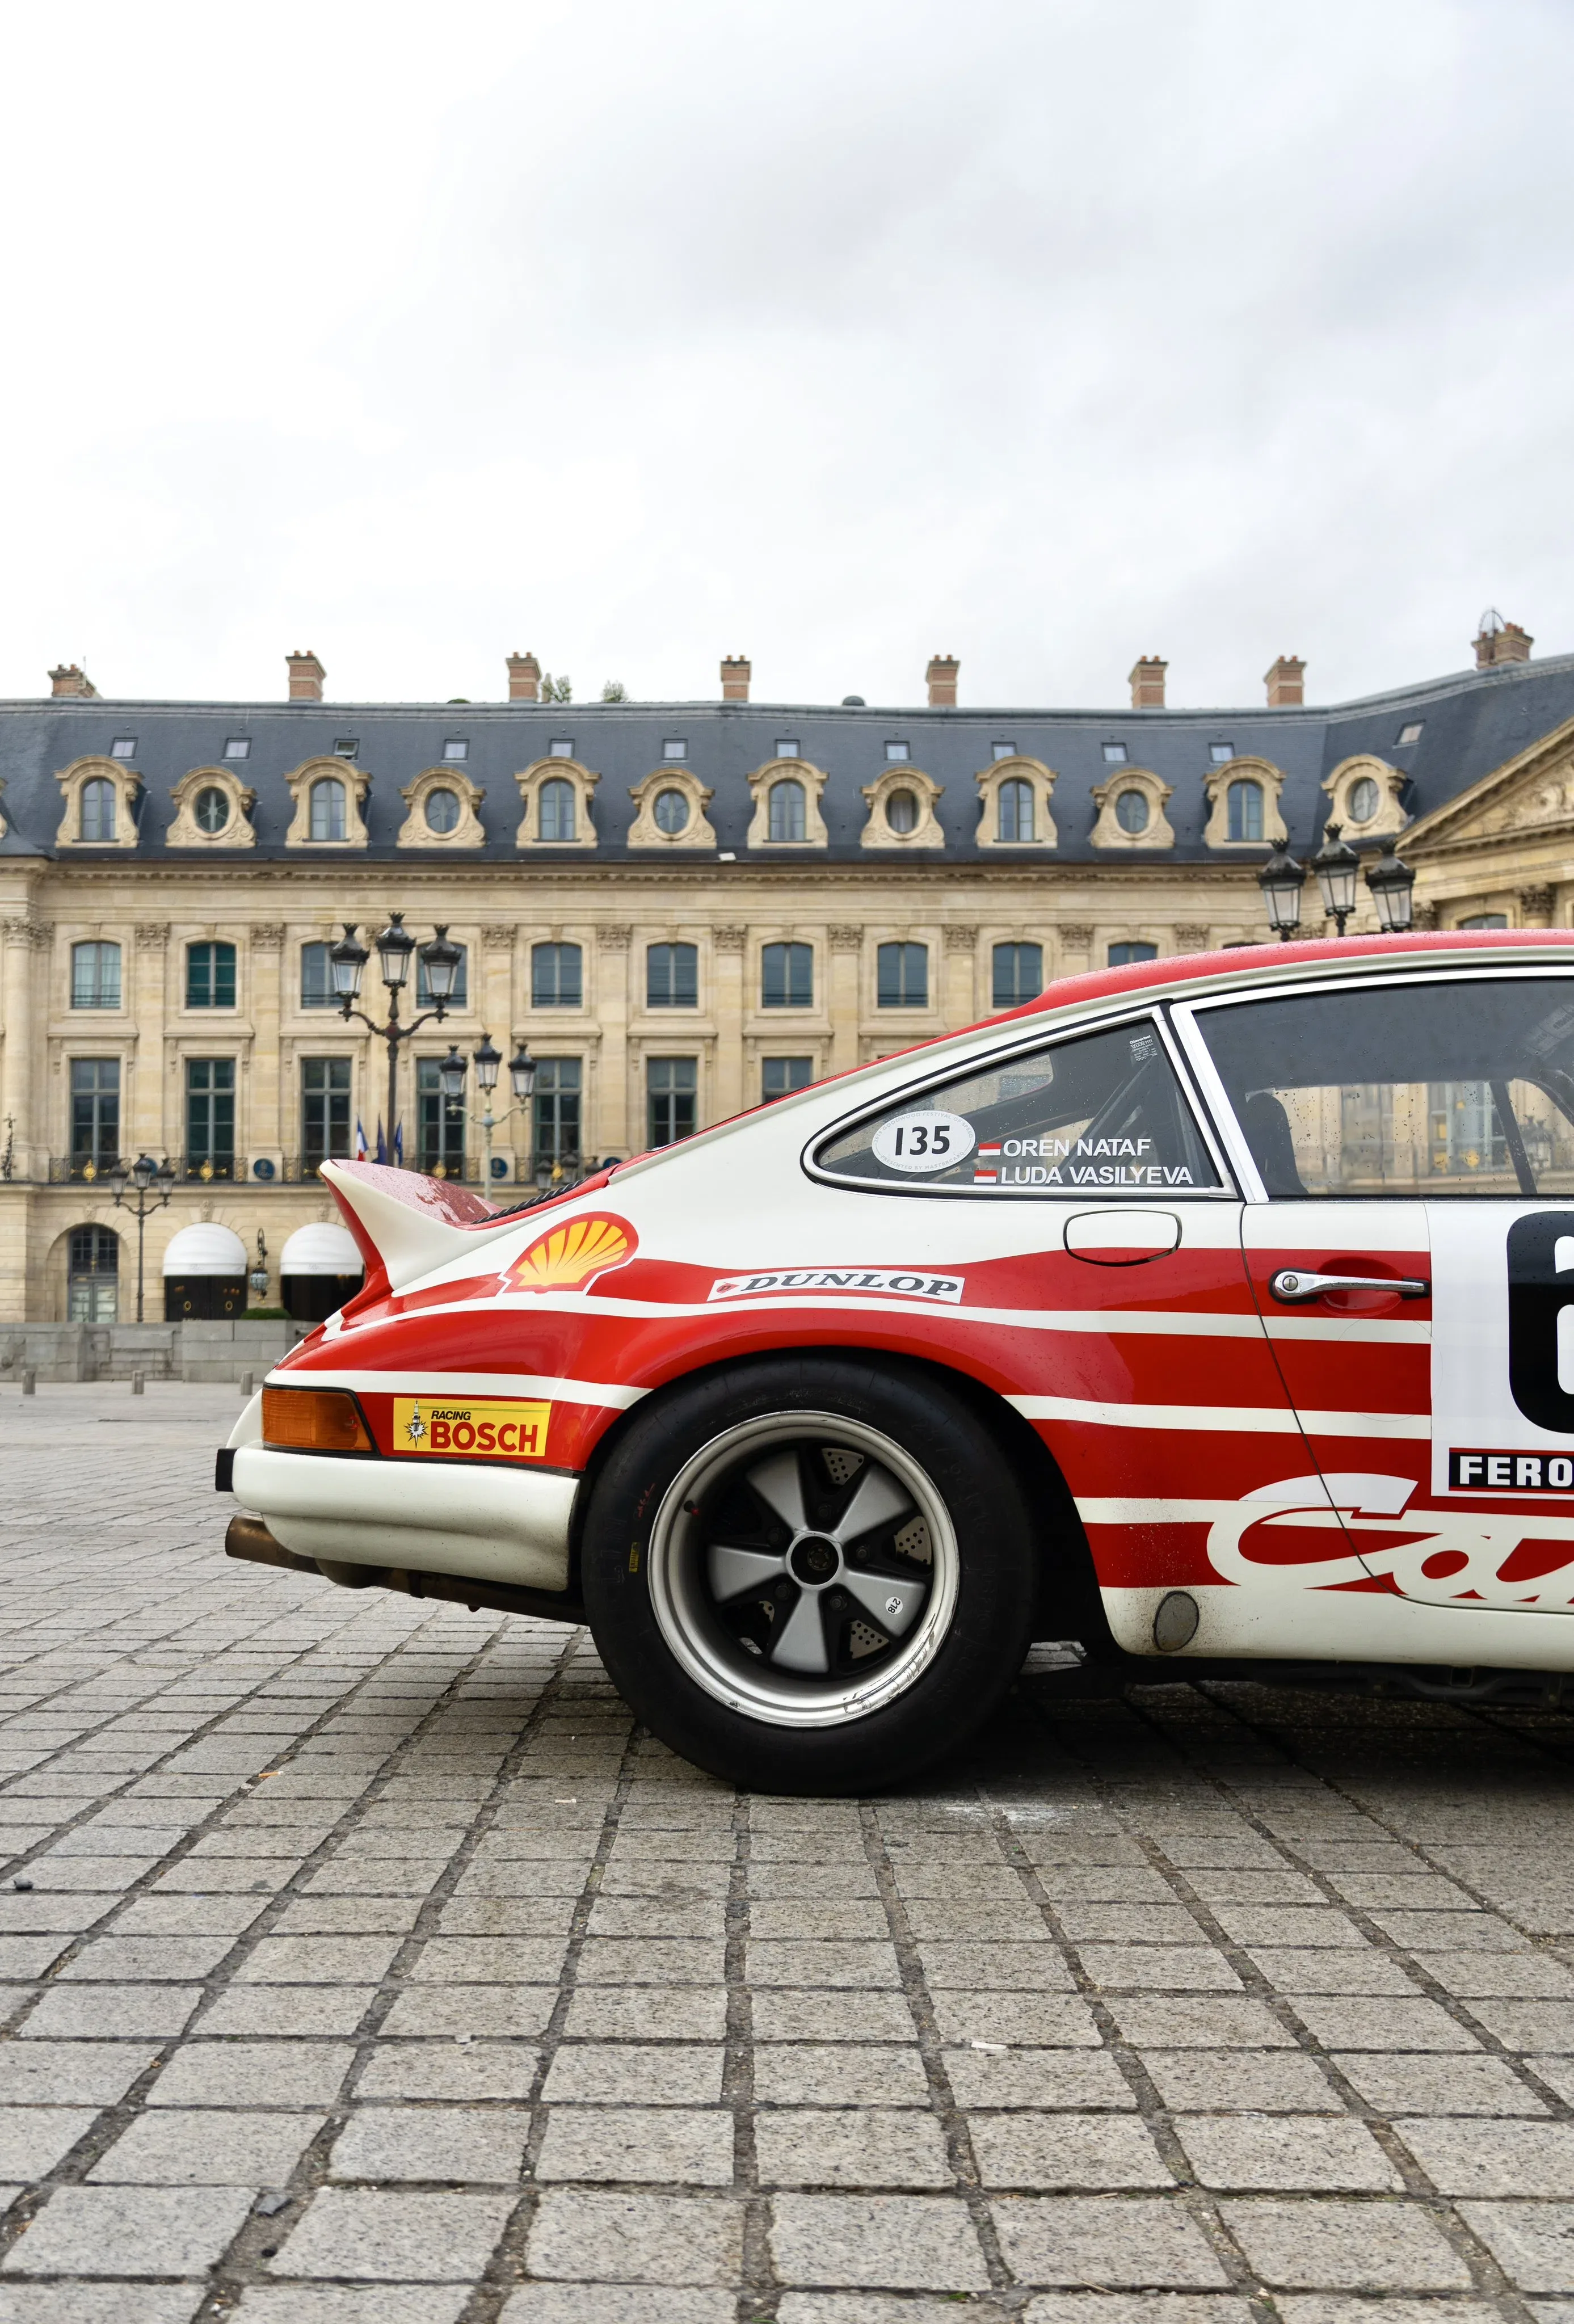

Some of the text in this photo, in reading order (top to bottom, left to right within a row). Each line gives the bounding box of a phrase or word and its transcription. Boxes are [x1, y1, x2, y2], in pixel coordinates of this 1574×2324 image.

[883, 1113, 920, 1130] GOODWOOD
[962, 1122, 973, 1138] SPEED
[895, 1125, 950, 1156] 135
[1003, 1138, 1151, 1157] OREN NATAF
[881, 1155, 912, 1170] PRESENTED
[925, 1151, 965, 1170] MASTERCARD
[1001, 1166, 1194, 1185] LUDA VASILYEVA
[740, 1273, 958, 1296] DUNLOP
[431, 1411, 472, 1421] RACING
[430, 1421, 538, 1452] BOSCH
[1459, 1455, 1573, 1487] FERO
[1206, 1472, 1574, 1602] Ca
[887, 1598, 901, 1614] 218
